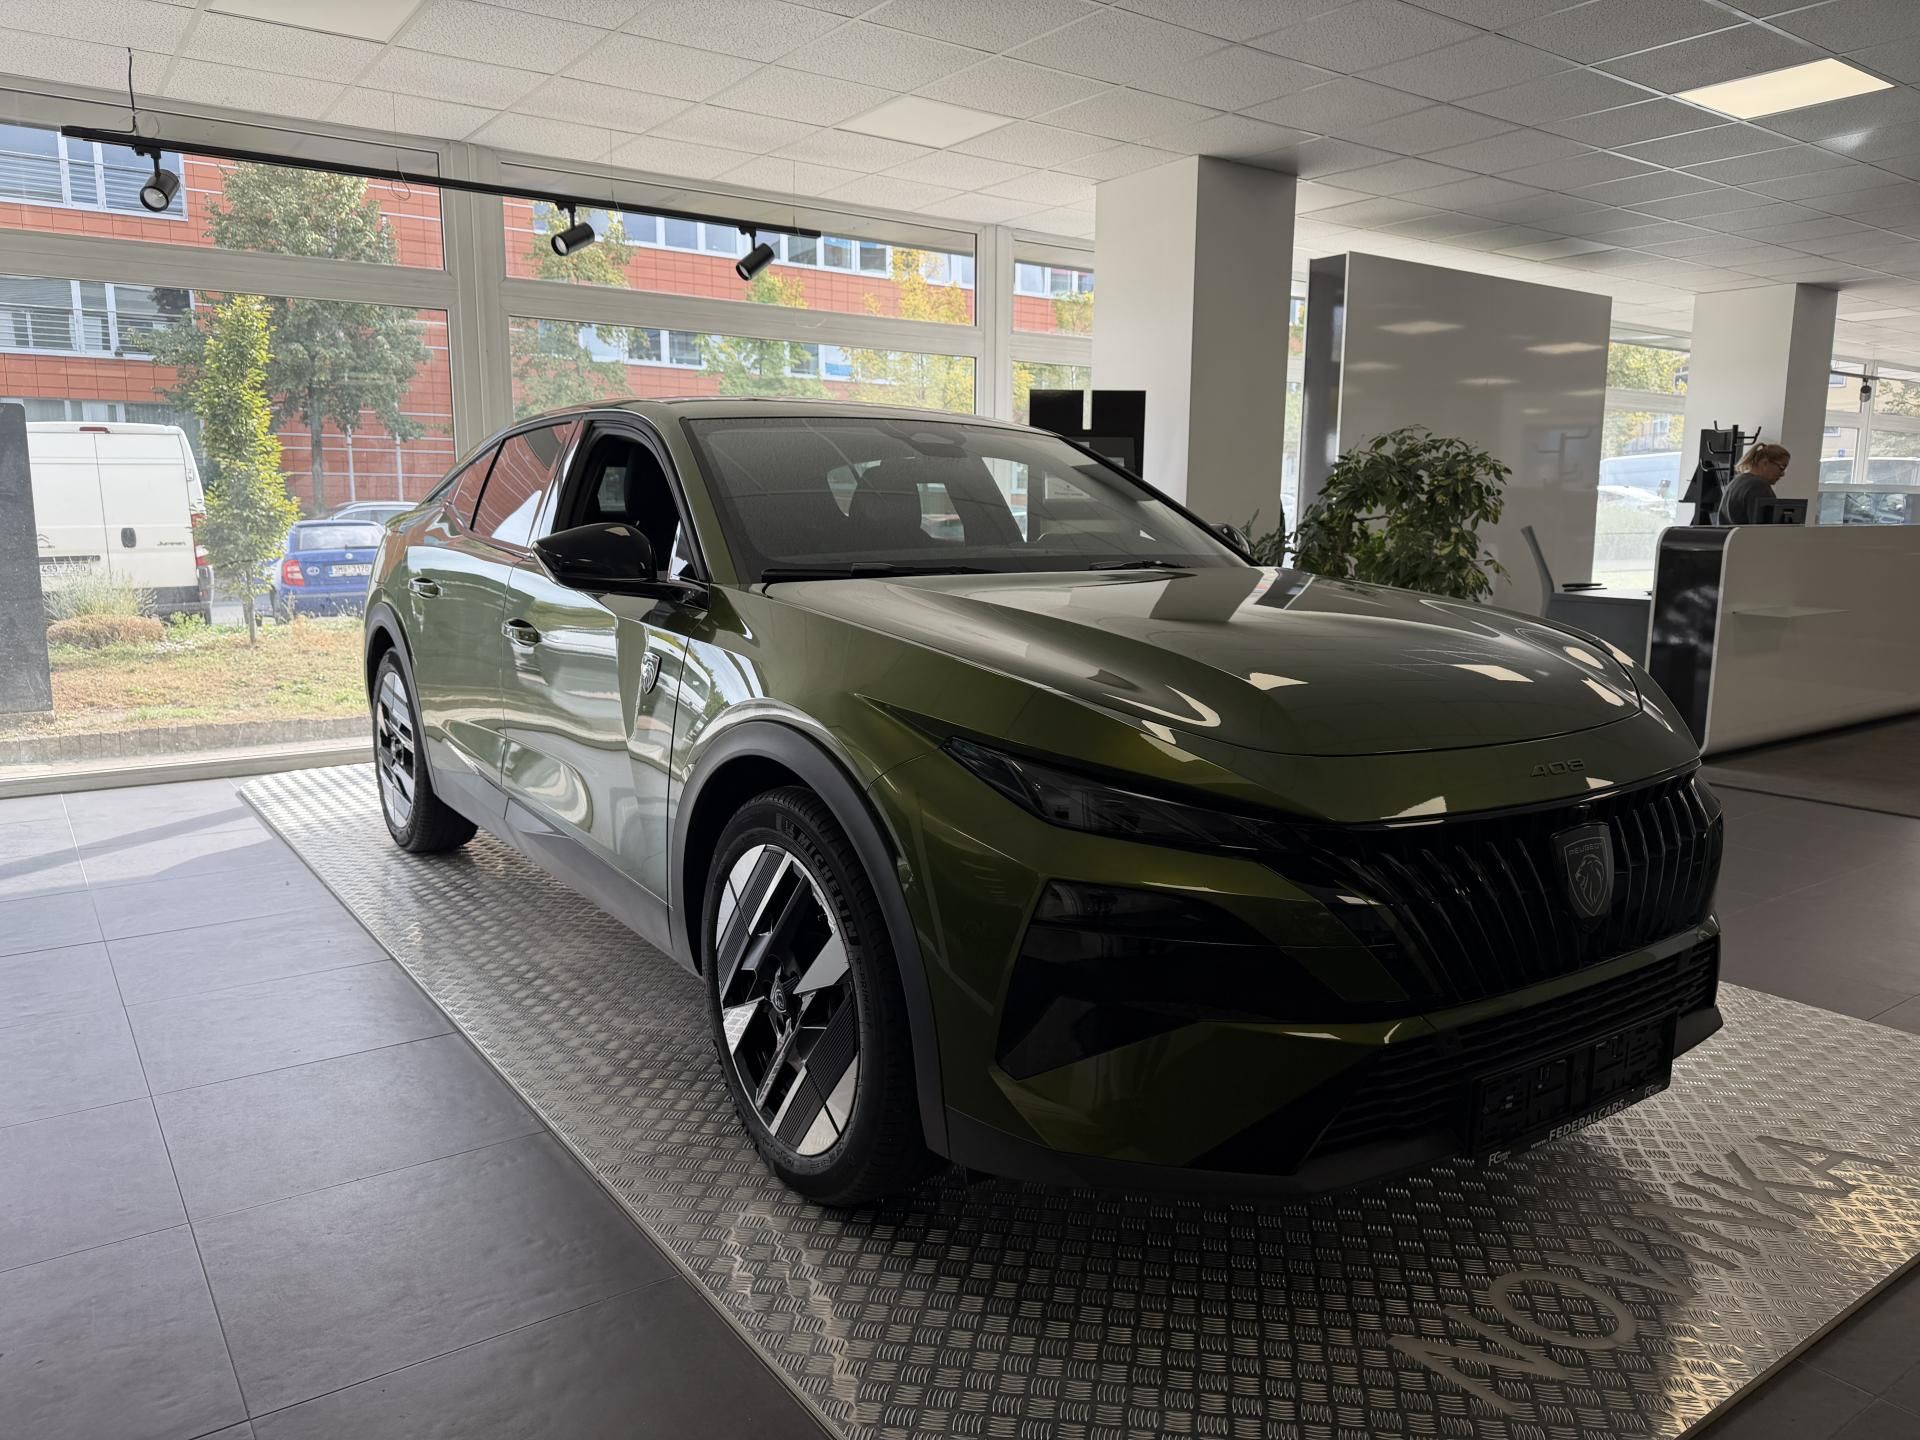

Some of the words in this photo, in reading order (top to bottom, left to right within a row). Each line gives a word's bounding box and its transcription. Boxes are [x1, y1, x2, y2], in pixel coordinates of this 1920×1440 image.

[1530, 758, 1585, 777] 408
[796, 831, 858, 937] MICHELIN
[1387, 1134, 1894, 1415] NOVINKA
